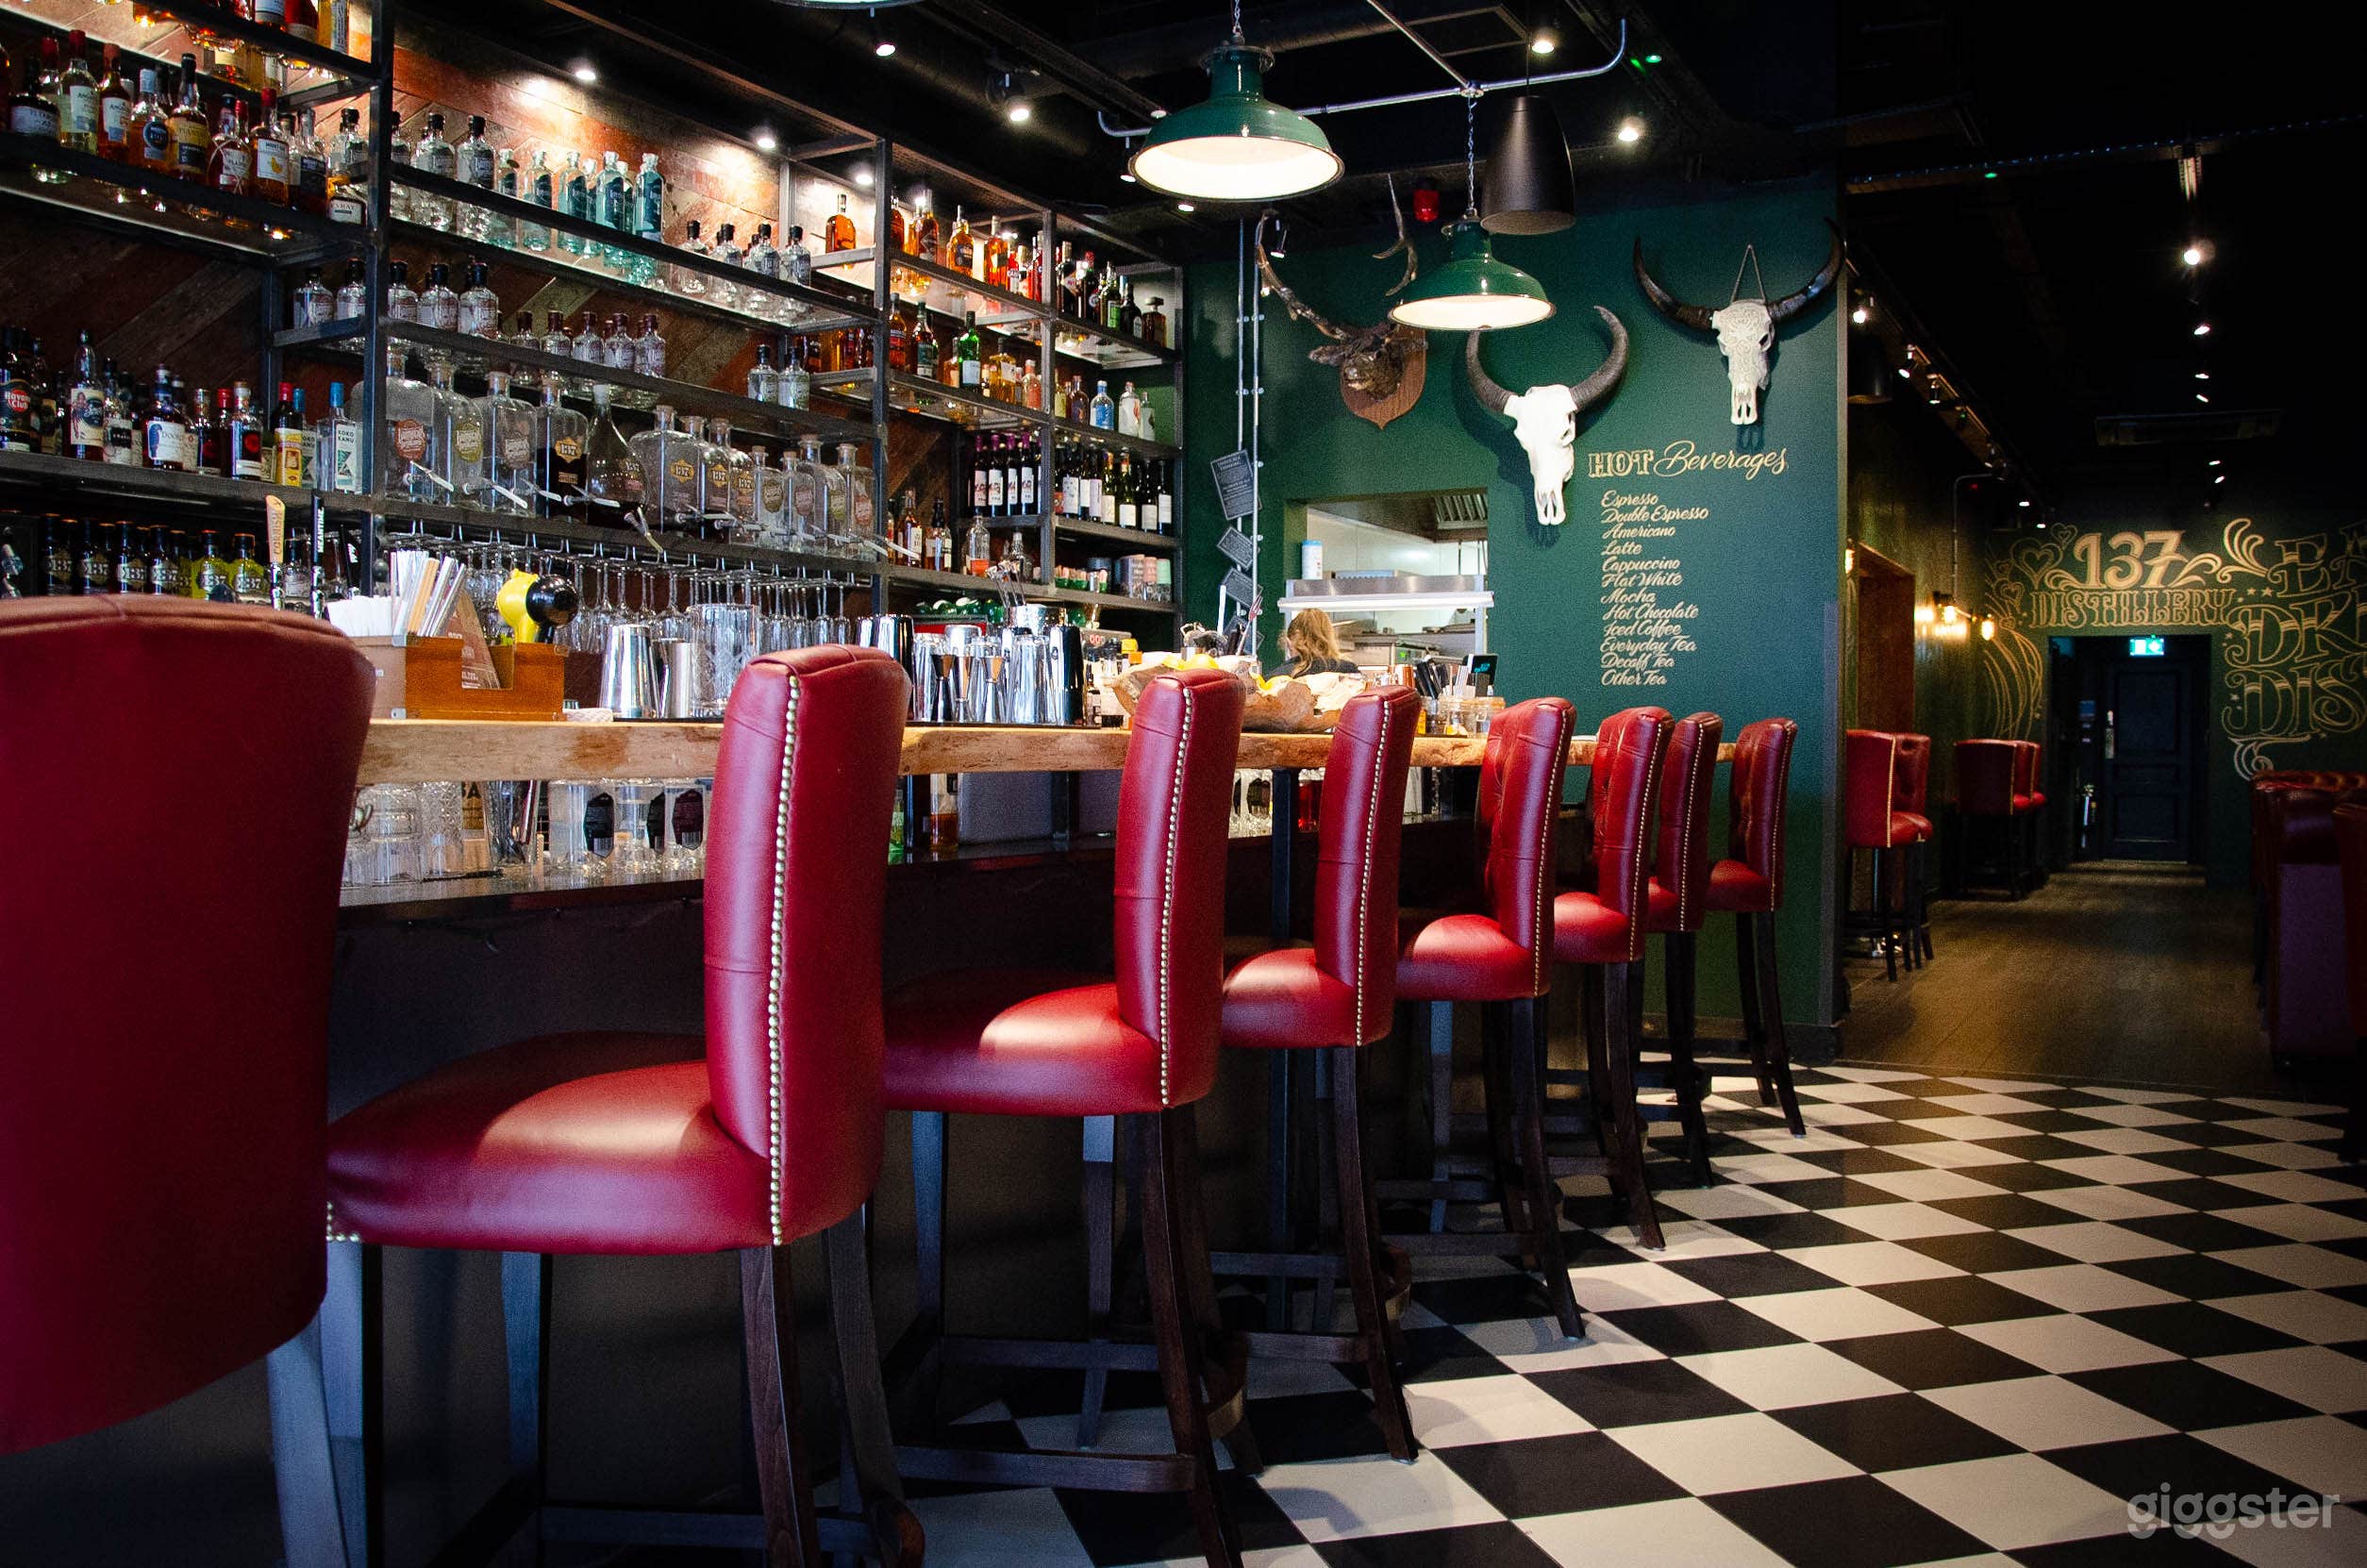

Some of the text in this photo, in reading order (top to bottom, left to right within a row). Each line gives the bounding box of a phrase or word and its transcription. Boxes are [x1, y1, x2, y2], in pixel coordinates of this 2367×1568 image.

[5, 390, 31, 403] Havana
[11, 401, 29, 409] Club
[338, 429, 354, 438] KOKO
[1588, 440, 1788, 480] HOT Beverages
[1601, 490, 1659, 509] Espresso
[1601, 505, 1709, 524] Double Espresso
[1602, 523, 1676, 539] Americano
[1601, 540, 1642, 556] Latte
[1602, 556, 1680, 573] Cappuccino
[2073, 530, 2189, 590] 137
[1601, 570, 1683, 588] Flat White
[1600, 586, 1657, 604] Mocha
[1602, 601, 1699, 620] Hot Chocolate
[2029, 588, 2237, 629] DISTILLERY
[1603, 619, 1682, 638] Iced Coffee
[1600, 635, 1697, 657] Everyday Tea
[1601, 652, 1675, 671] Decaff Tea
[1601, 669, 1667, 686] Other Tea
